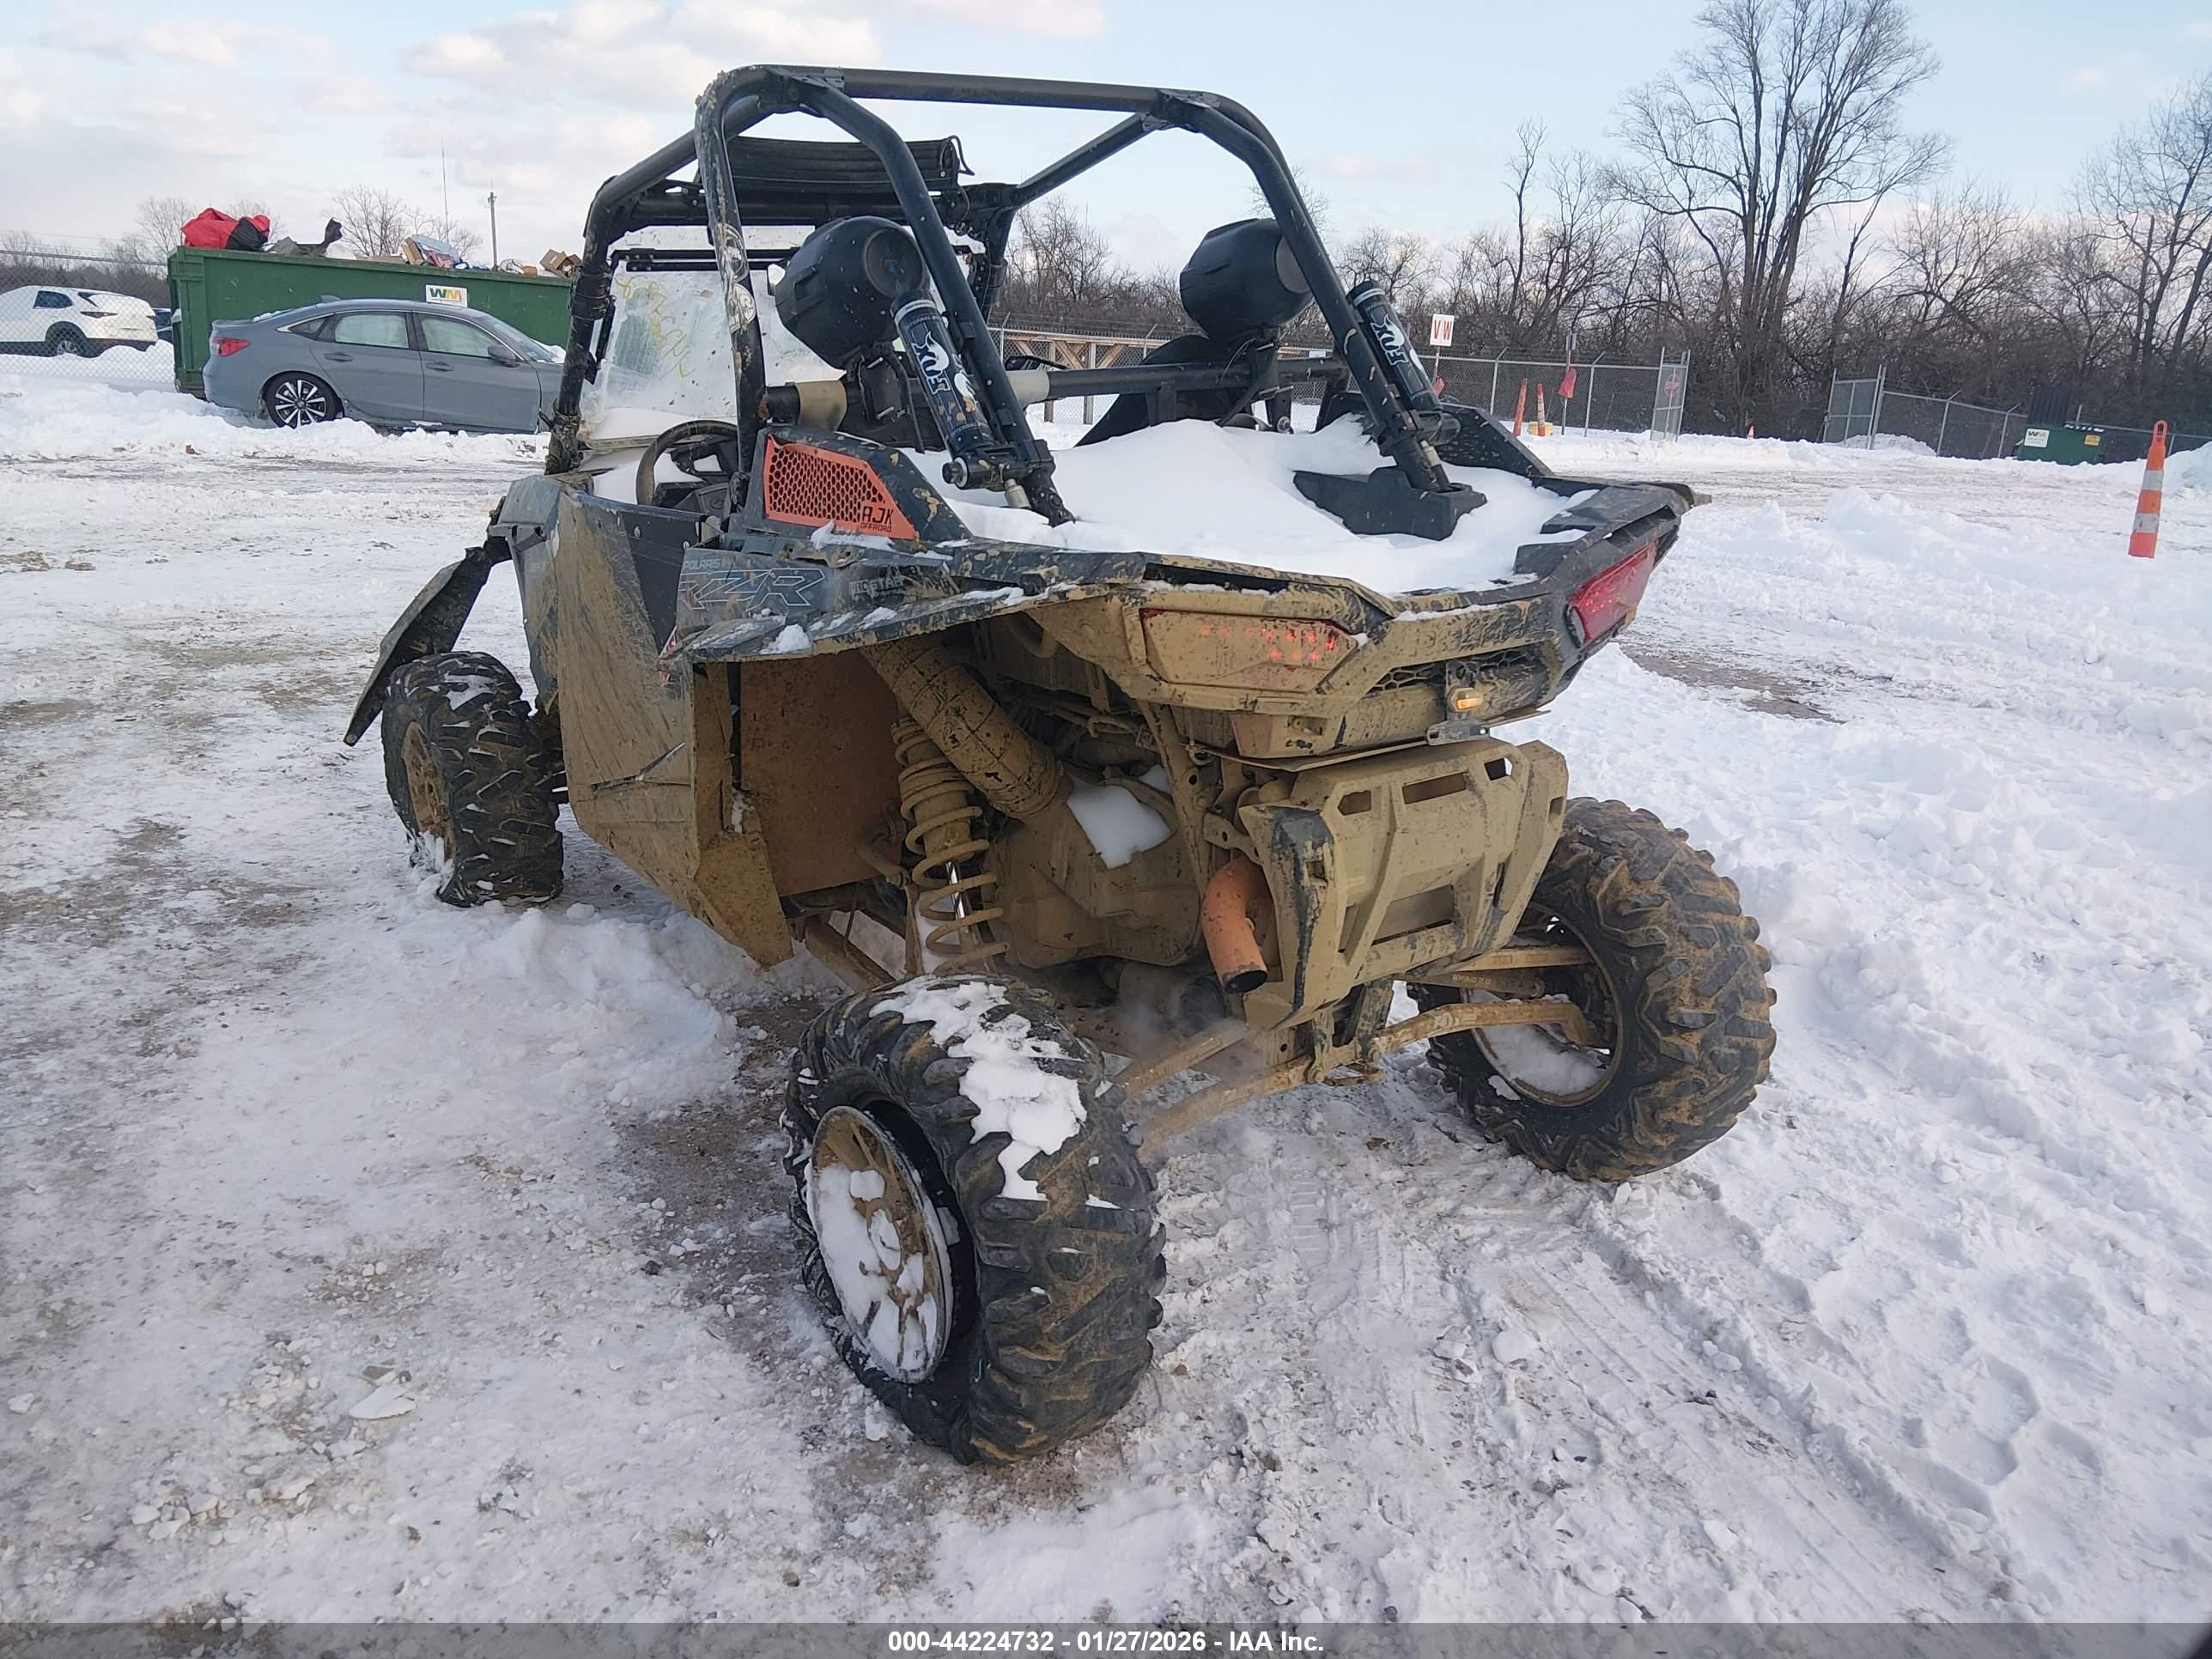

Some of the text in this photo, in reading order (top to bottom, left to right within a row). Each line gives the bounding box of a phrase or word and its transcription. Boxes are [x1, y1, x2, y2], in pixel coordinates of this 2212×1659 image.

[430, 288, 461, 300] WM
[1370, 314, 1408, 365] FOX
[911, 331, 951, 395] FOX
[861, 506, 893, 525] AJK
[860, 521, 891, 533] OFFROAD
[683, 559, 720, 570] POLARIS
